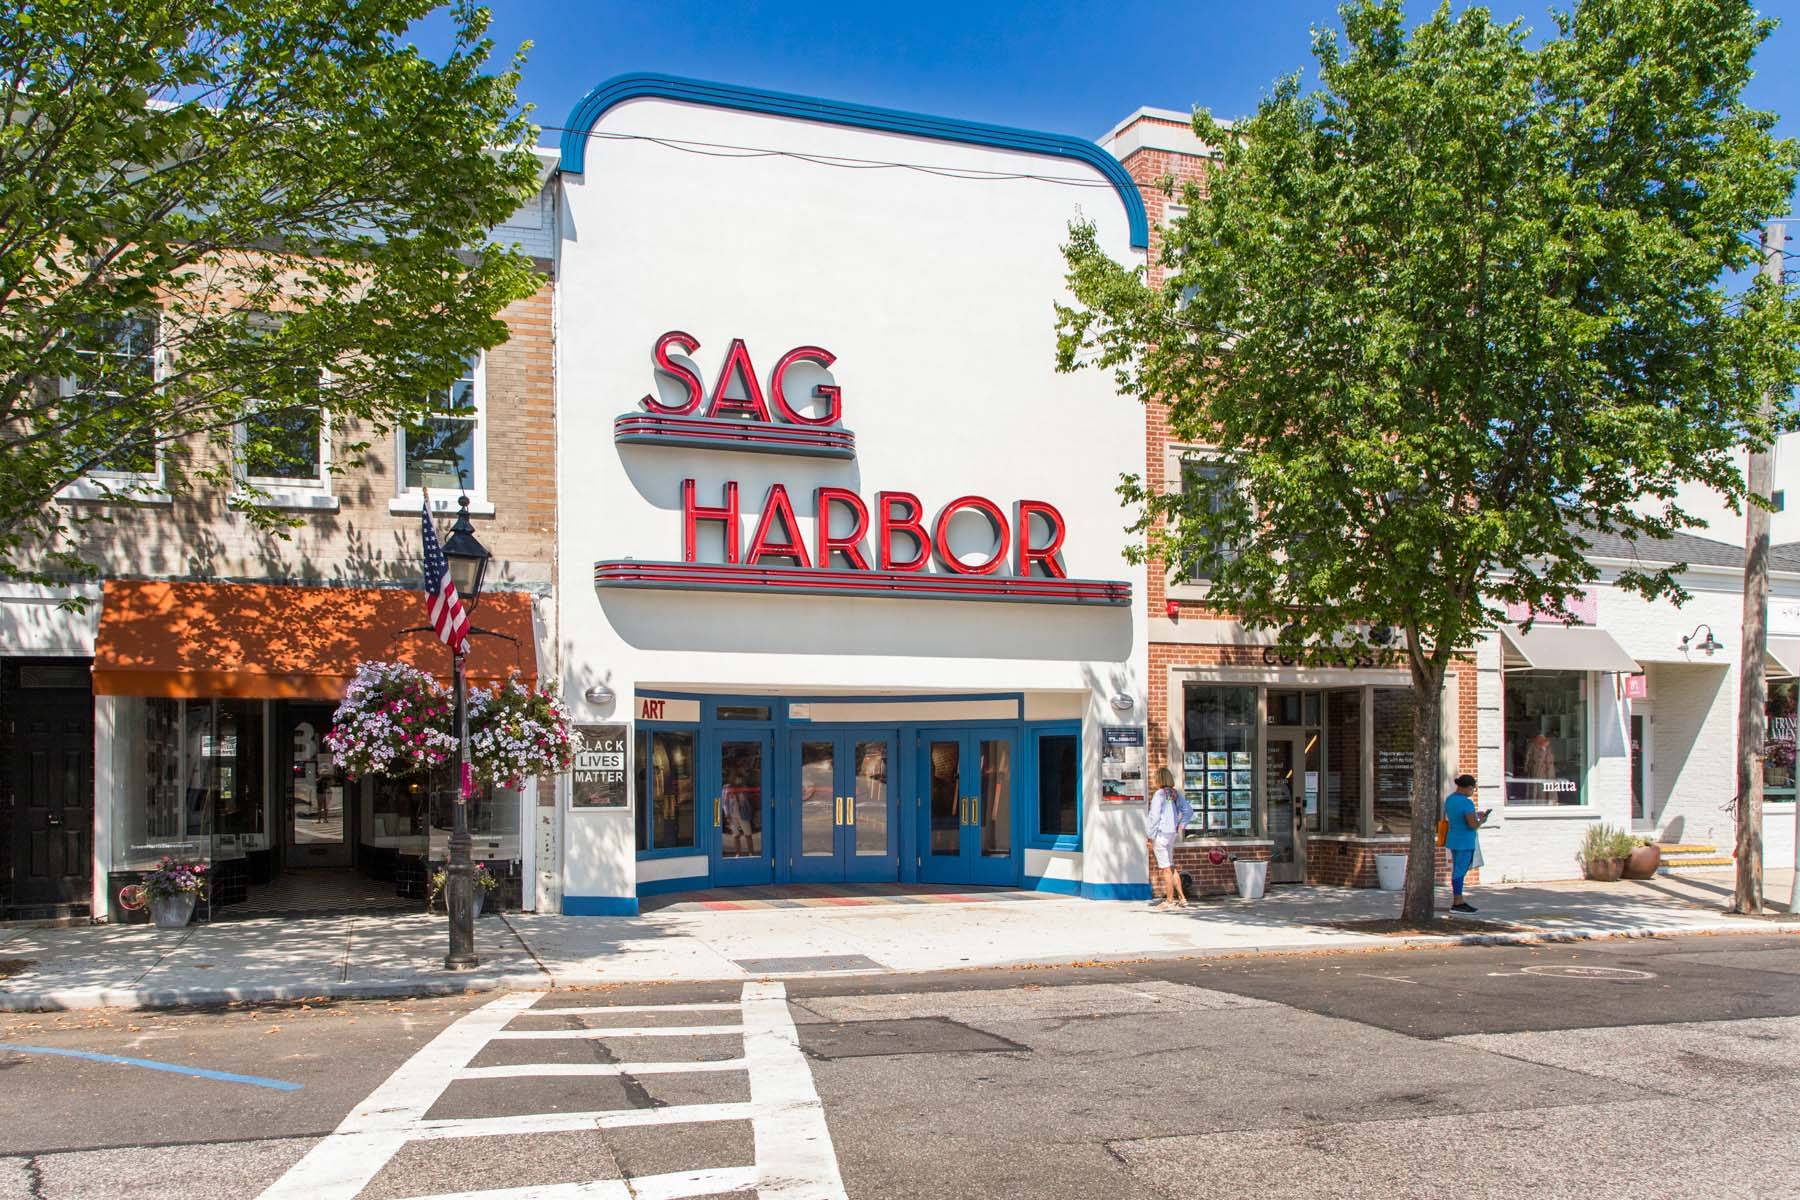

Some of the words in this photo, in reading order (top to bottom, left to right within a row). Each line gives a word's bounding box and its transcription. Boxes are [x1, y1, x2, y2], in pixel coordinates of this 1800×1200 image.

[638, 330, 842, 427] SAG
[680, 478, 1067, 579] HARBOR
[641, 699, 666, 719] ART
[580, 755, 620, 767] LIVES
[575, 771, 624, 783] MATTER
[1543, 781, 1576, 792] matta
